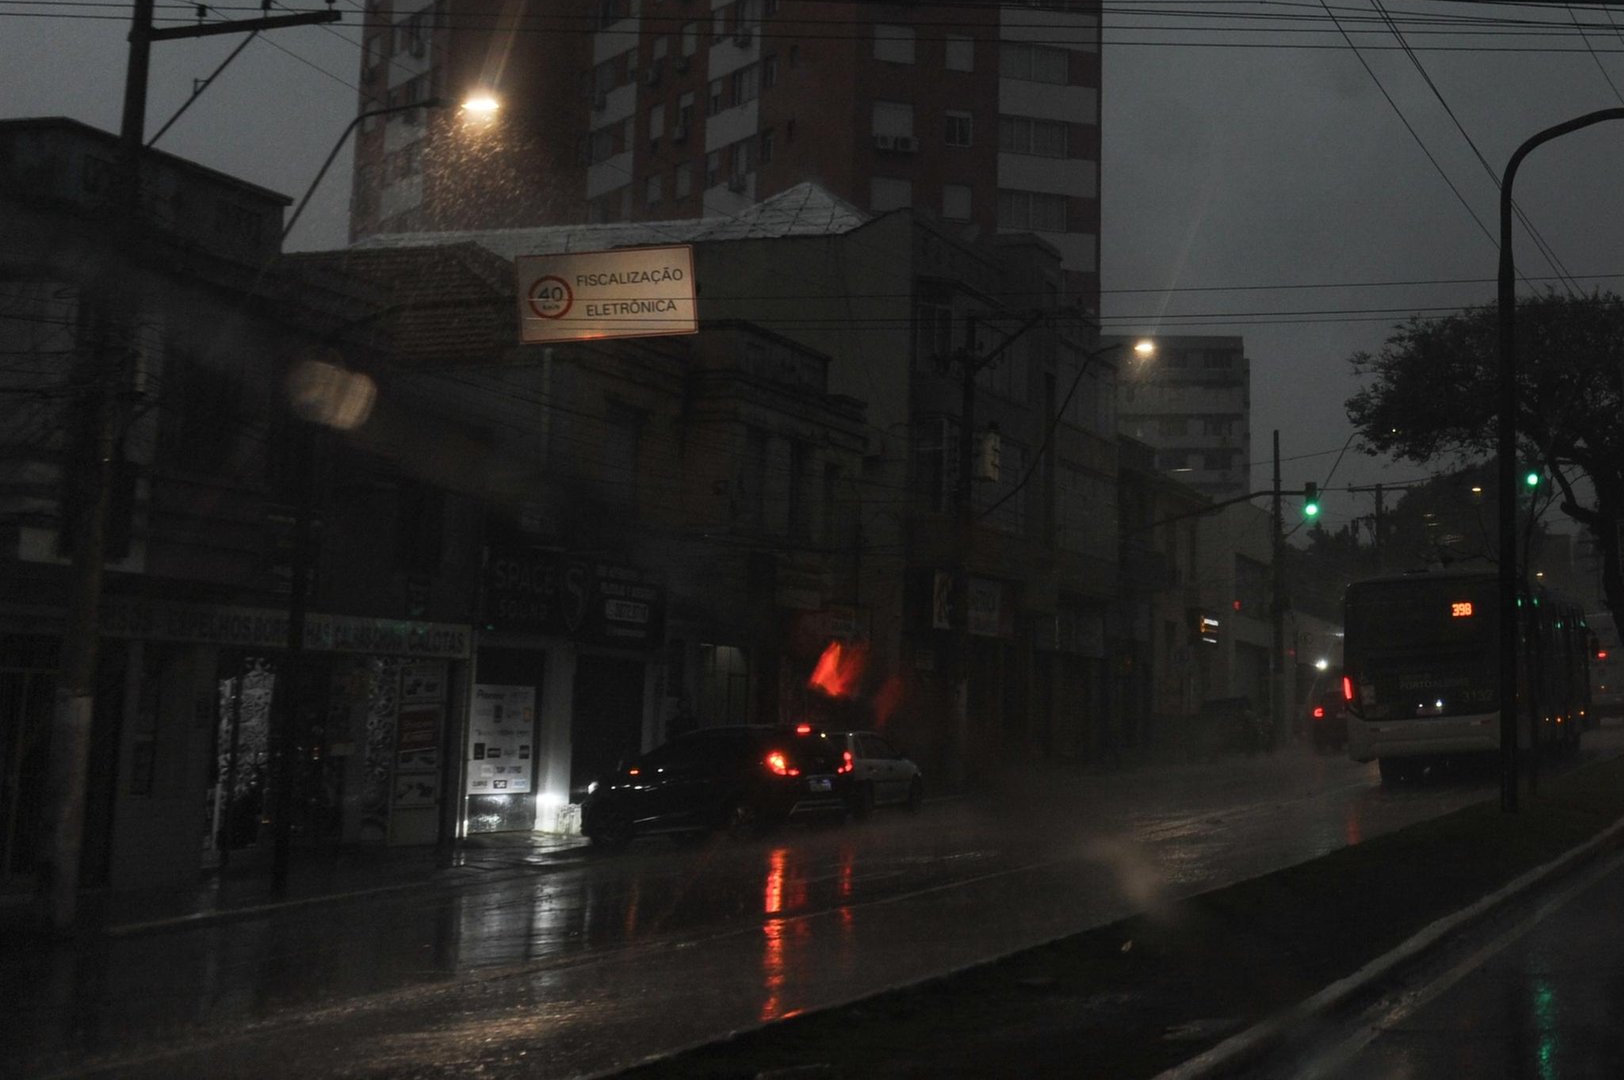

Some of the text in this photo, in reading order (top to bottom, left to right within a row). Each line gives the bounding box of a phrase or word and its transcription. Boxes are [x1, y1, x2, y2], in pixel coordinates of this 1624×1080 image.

[576, 266, 684, 287] FISCALIZAÇÃO
[538, 286, 564, 303] 40
[586, 299, 677, 317] ELETRÔNICA
[494, 558, 555, 596] SPACE
[1452, 602, 1473, 617] 398
